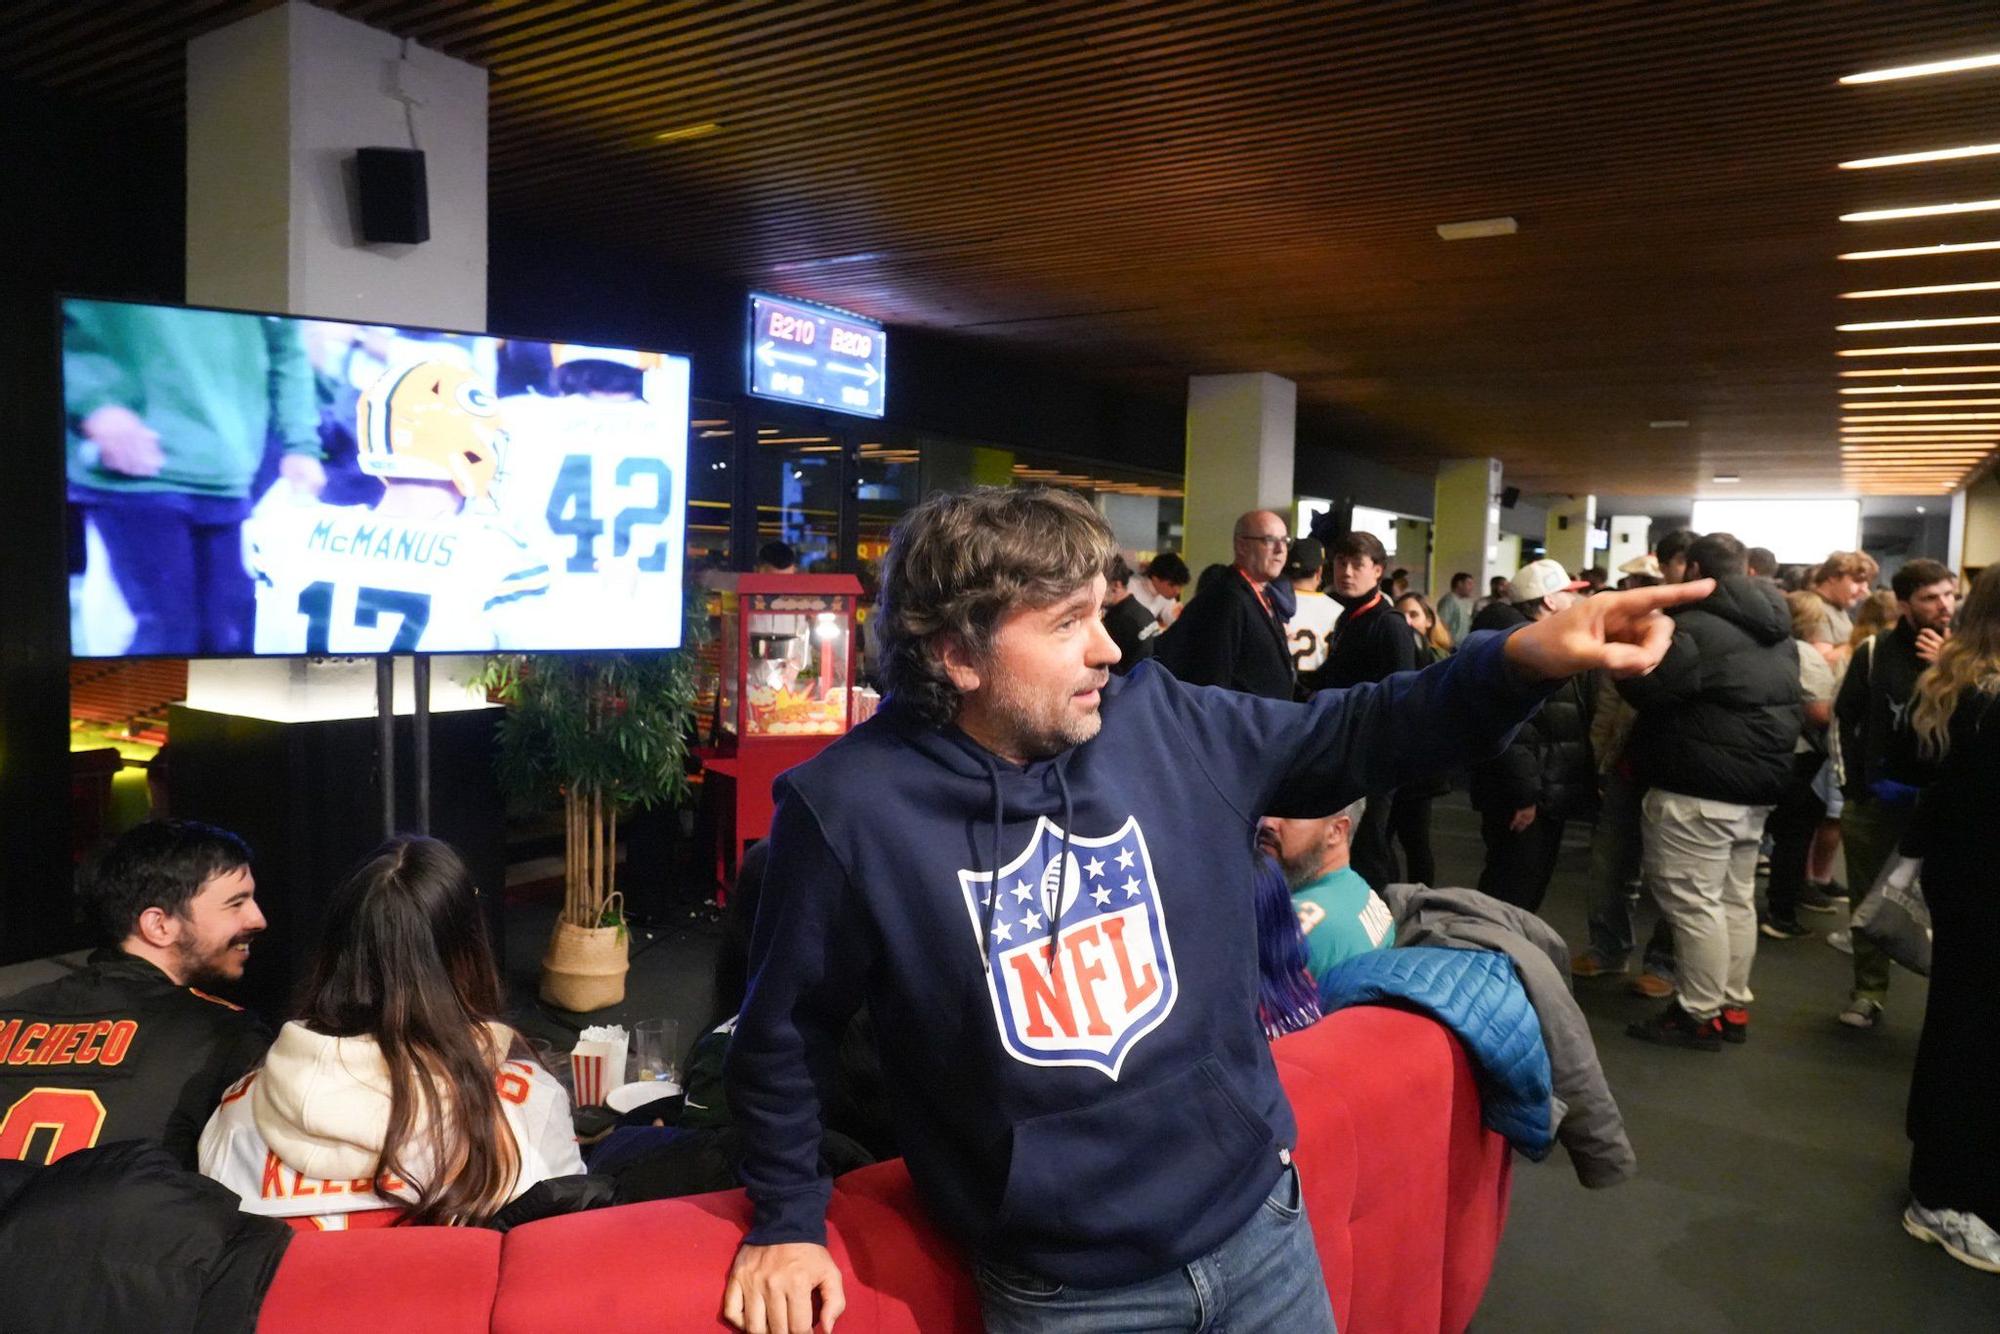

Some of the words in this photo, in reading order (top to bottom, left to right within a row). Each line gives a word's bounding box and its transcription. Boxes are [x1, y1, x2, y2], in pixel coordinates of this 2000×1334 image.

[769, 312, 816, 345] B210
[308, 519, 458, 567] McMANUS
[546, 454, 673, 573] 42
[297, 580, 432, 653] 17
[1009, 916, 1158, 1038] NFL
[0, 1018, 139, 1066] ACHECO
